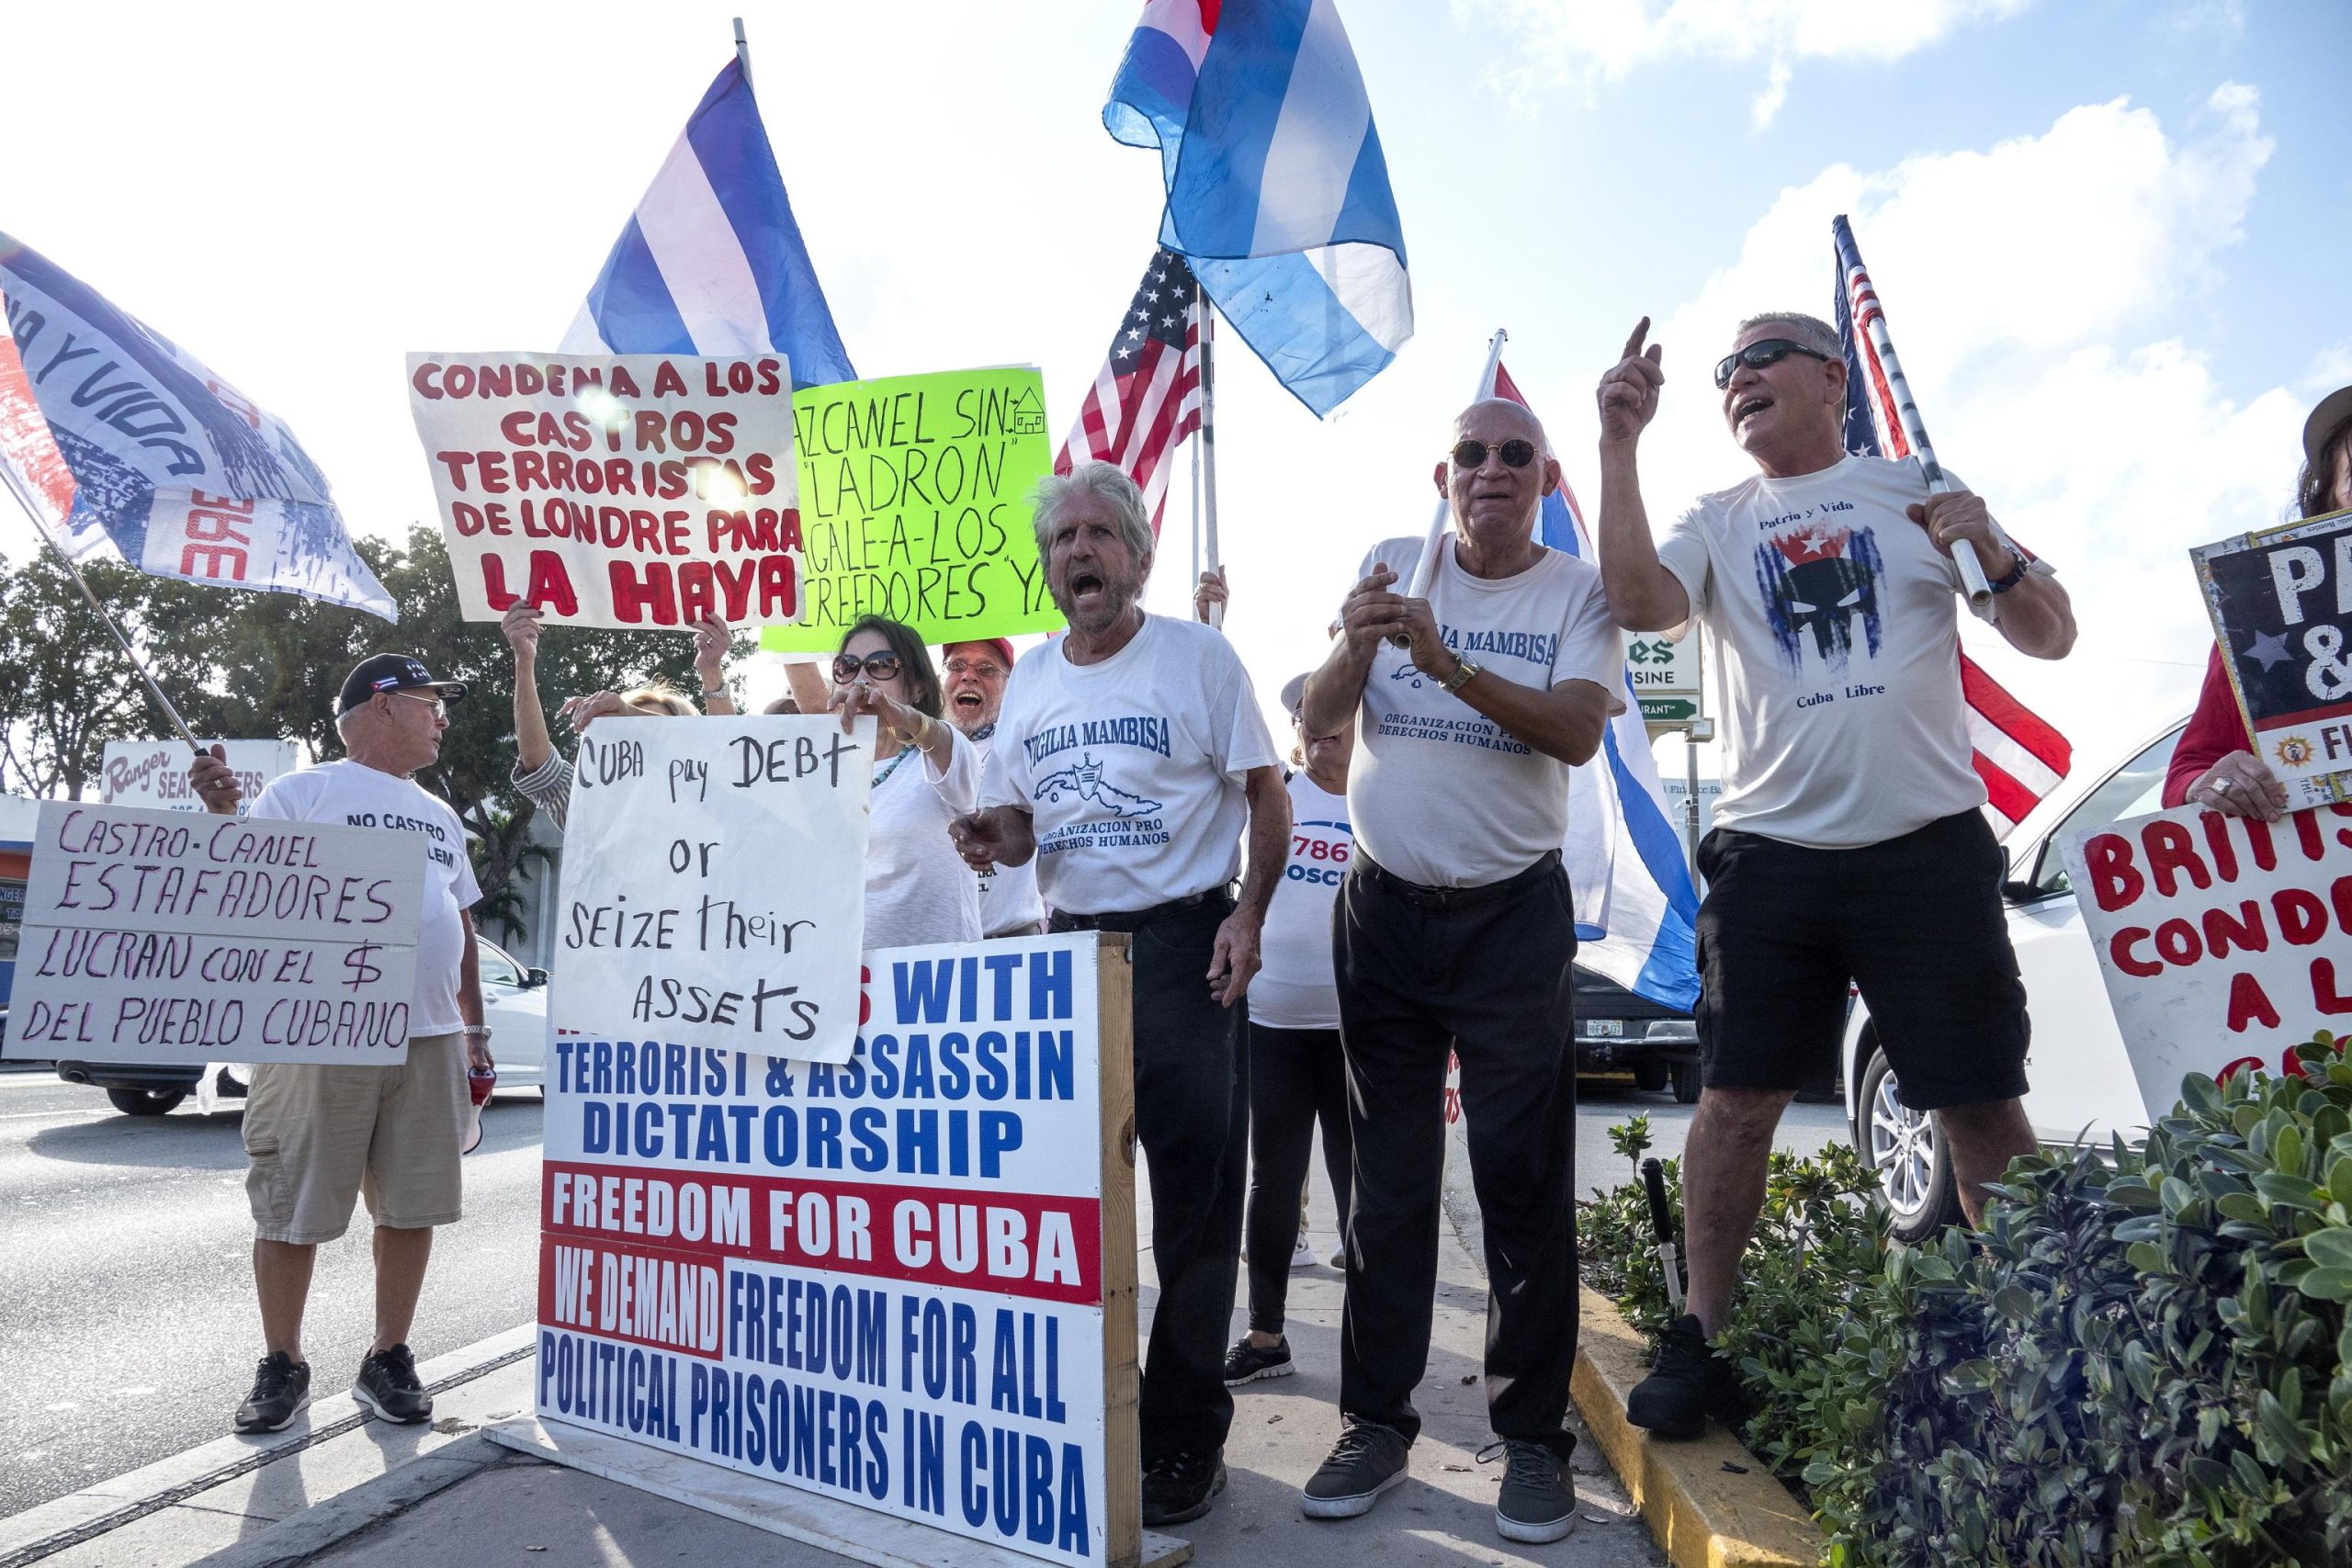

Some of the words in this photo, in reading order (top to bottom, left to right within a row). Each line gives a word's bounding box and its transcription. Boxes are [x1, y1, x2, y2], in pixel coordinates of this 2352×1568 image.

[35, 333, 99, 386] Y
[70, 360, 207, 478] VIDA
[413, 362, 640, 400] CONDENA
[653, 360, 687, 398] A
[707, 358, 780, 397] LOS
[500, 409, 738, 454] CASTROS
[951, 387, 1009, 438] SIN
[452, 501, 513, 536] DE
[521, 498, 690, 555] LONDRE
[707, 508, 803, 553] PARA
[1759, 512, 1801, 530] Patria
[1806, 508, 1815, 518] y
[1819, 501, 1854, 513] Vida
[481, 550, 578, 616] LA
[608, 555, 797, 626] HAYA
[1464, 631, 1558, 666] MAMBISA
[1796, 692, 1834, 708] Cuba
[1845, 683, 1885, 699] Libre
[1023, 724, 1077, 774] VIGILIA
[1082, 716, 1170, 759] MAMBISA
[1378, 724, 1449, 740] DERECHOS
[1454, 733, 1531, 755] HUMANOS
[1385, 713, 1494, 736] ORGANIZACION
[104, 750, 171, 804] Ranger
[578, 736, 644, 788] CUBA
[669, 755, 708, 803] pay
[347, 814, 377, 827] NO
[383, 814, 445, 842] CASTRO
[1038, 834, 1093, 857] DERECHOS
[1098, 831, 1170, 847] HUMANOS
[1135, 818, 1163, 831] PRO
[669, 839, 721, 878] or
[54, 861, 393, 925] ESTAFADORES
[36, 929, 192, 979] LUCRAN
[200, 946, 265, 984] CON
[272, 950, 314, 985] EL
[341, 939, 383, 992] $
[892, 950, 1073, 1025] WITH
[21, 1001, 94, 1043] DEL
[111, 997, 243, 1047] PUEBLO
[262, 998, 410, 1049] CUBANO
[2227, 972, 2281, 1032] A
[556, 1042, 747, 1096] TERRORIST
[806, 1031, 1075, 1101] ASSASSIN
[582, 1101, 1023, 1179] DICTATORSHIP
[552, 1172, 751, 1247] FREEDOM
[769, 1190, 872, 1261] FOR
[892, 1200, 1082, 1287] CUBA
[554, 1246, 593, 1328] WE
[600, 1251, 719, 1353] DEMAND
[729, 1269, 888, 1388] FREEDOM
[901, 1295, 977, 1406] FOR
[989, 1309, 1067, 1425] ALL
[541, 1331, 680, 1443] POLITICAL
[690, 1363, 889, 1501] PRISONERS
[903, 1409, 946, 1517] IN
[960, 1420, 1091, 1559] CUBA
